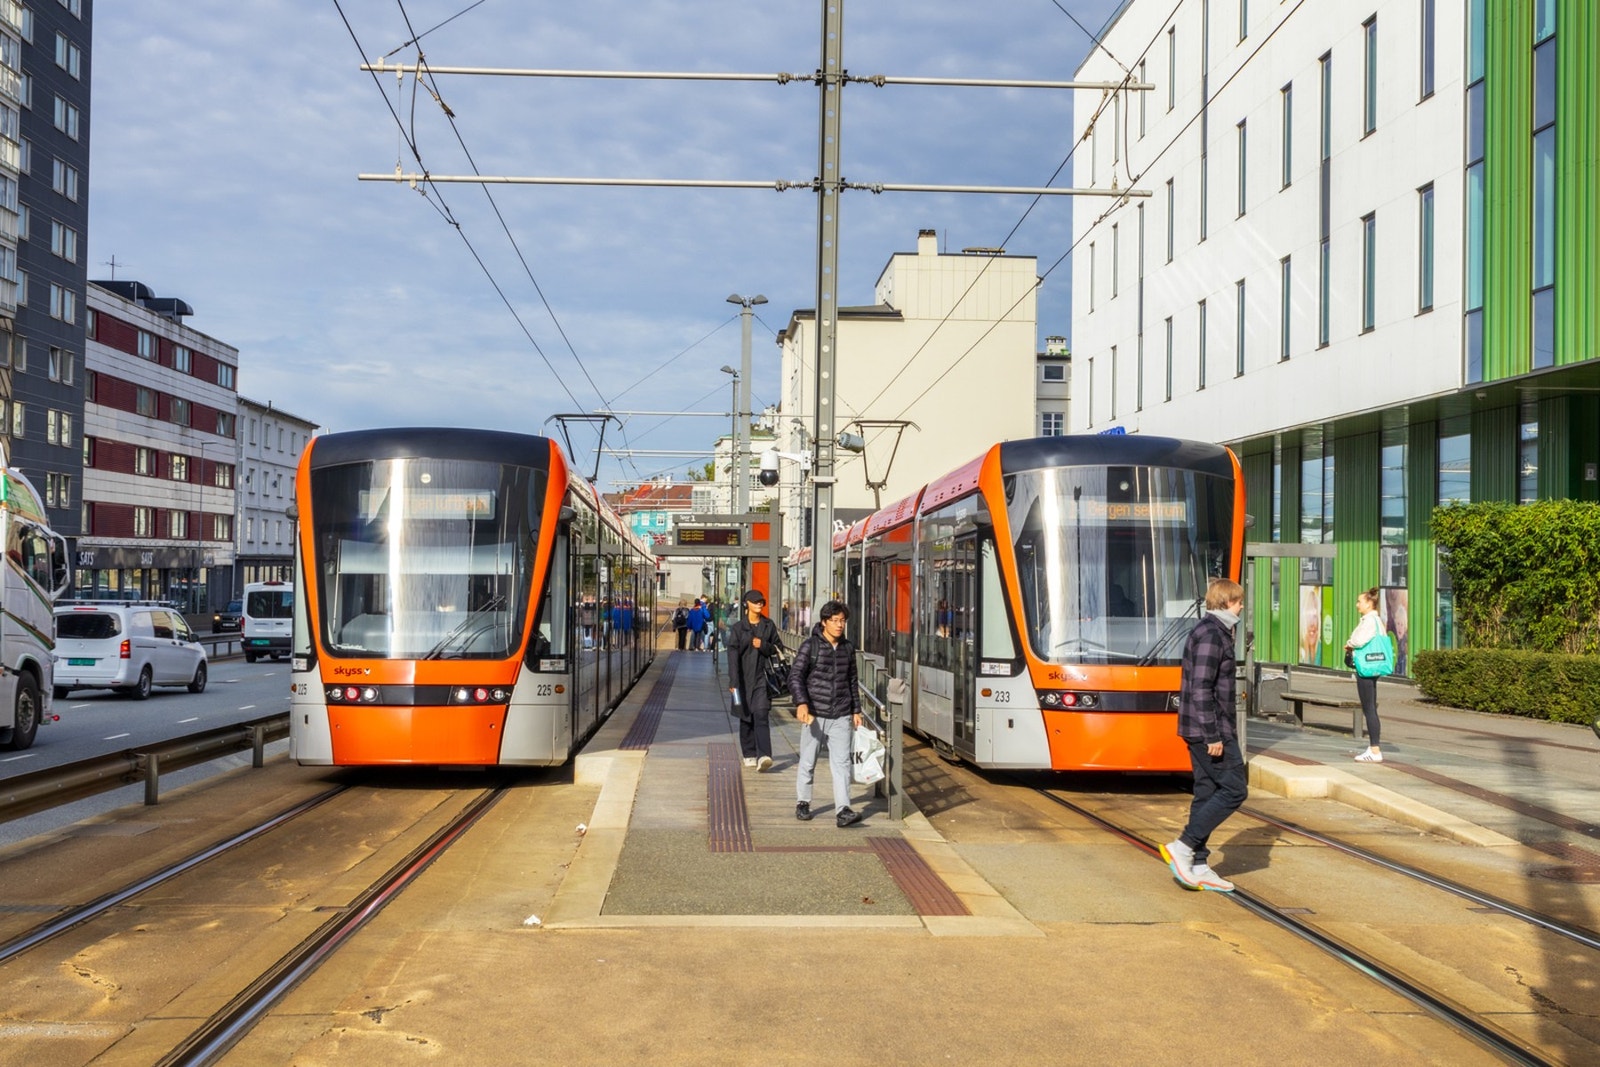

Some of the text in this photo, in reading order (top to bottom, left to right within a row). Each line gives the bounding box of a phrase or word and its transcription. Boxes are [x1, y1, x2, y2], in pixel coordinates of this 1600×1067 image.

[1087, 500, 1131, 519] Bergen
[1133, 502, 1184, 517] sentrum
[79, 551, 95, 565] SATS
[141, 551, 153, 565] SATS
[334, 666, 363, 676] skyss
[298, 684, 308, 696] 225
[537, 684, 552, 696] 225
[995, 690, 1010, 703] 233
